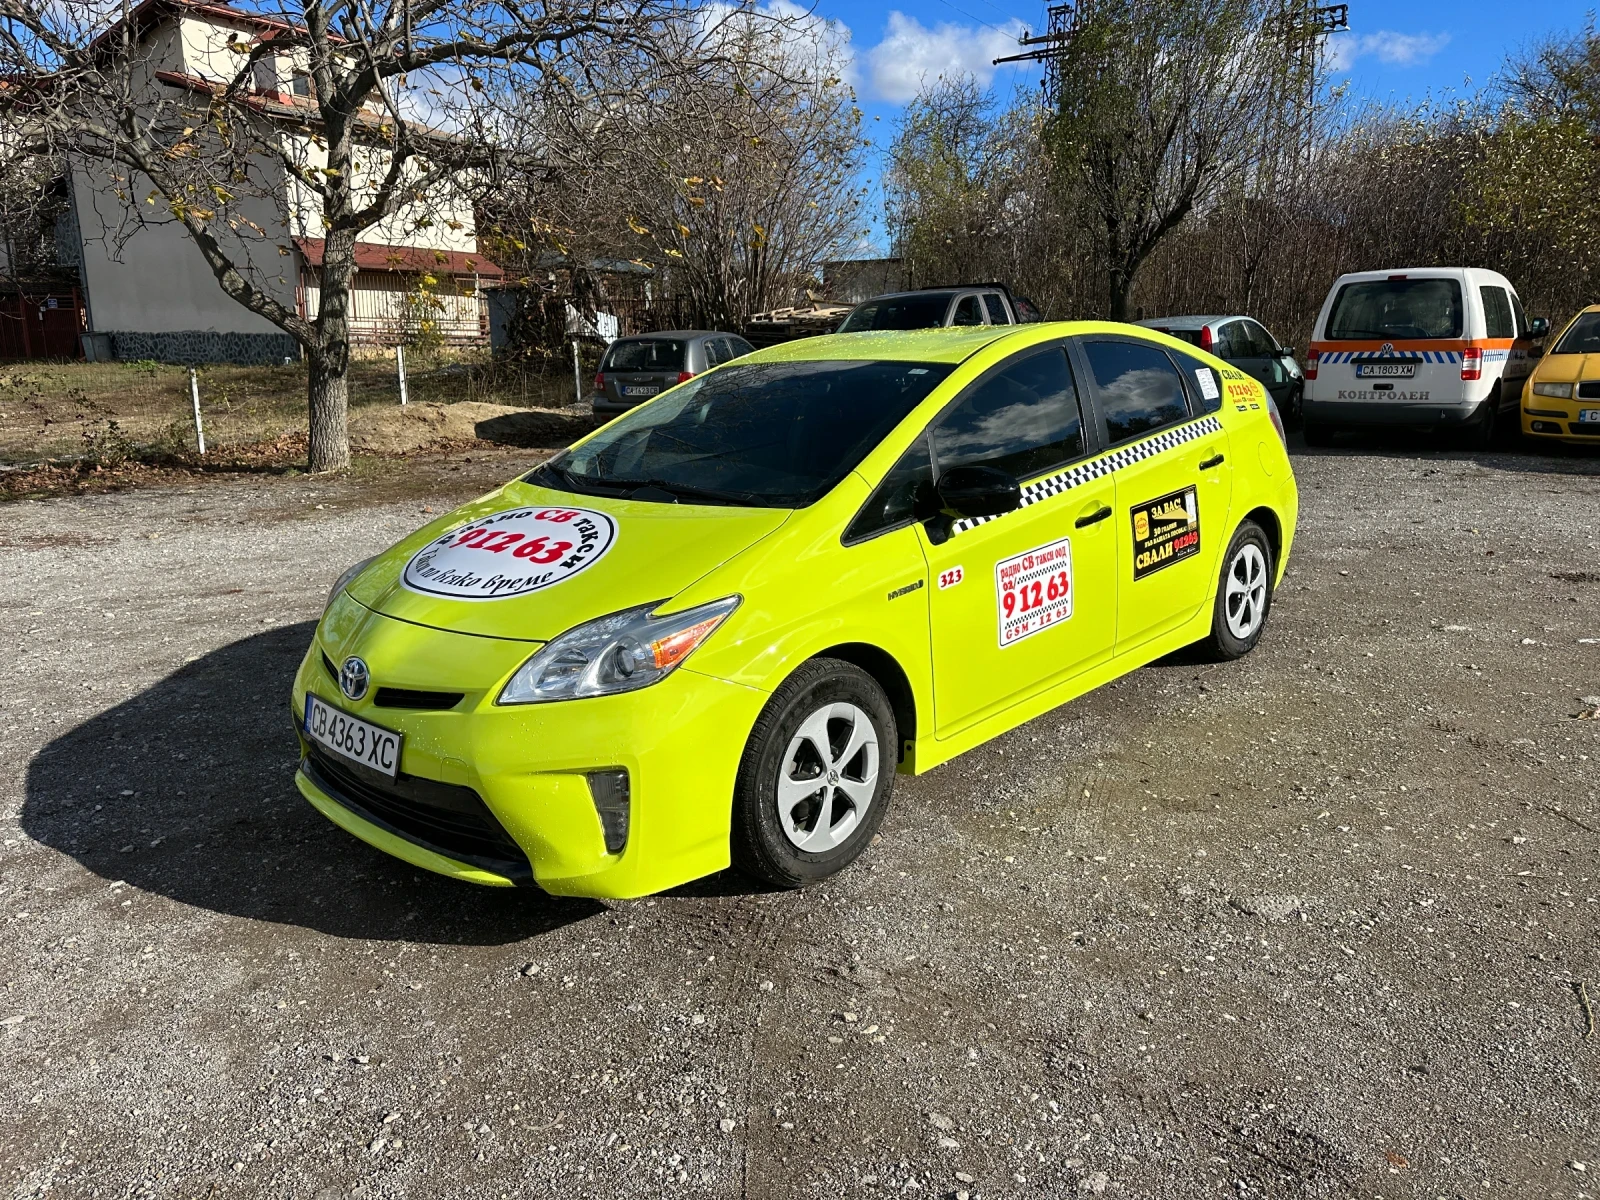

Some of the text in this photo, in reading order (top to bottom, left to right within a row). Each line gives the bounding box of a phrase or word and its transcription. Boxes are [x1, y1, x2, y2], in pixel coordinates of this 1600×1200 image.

[1228, 384, 1253, 398] 91263
[1338, 390, 1430, 401] КОНТРОЛЕН
[1151, 505, 1164, 519] ЗА
[1136, 541, 1173, 569] СВАЛИ
[1174, 531, 1198, 552] 91263
[940, 569, 962, 588] 323
[328, 715, 366, 757] 4363
